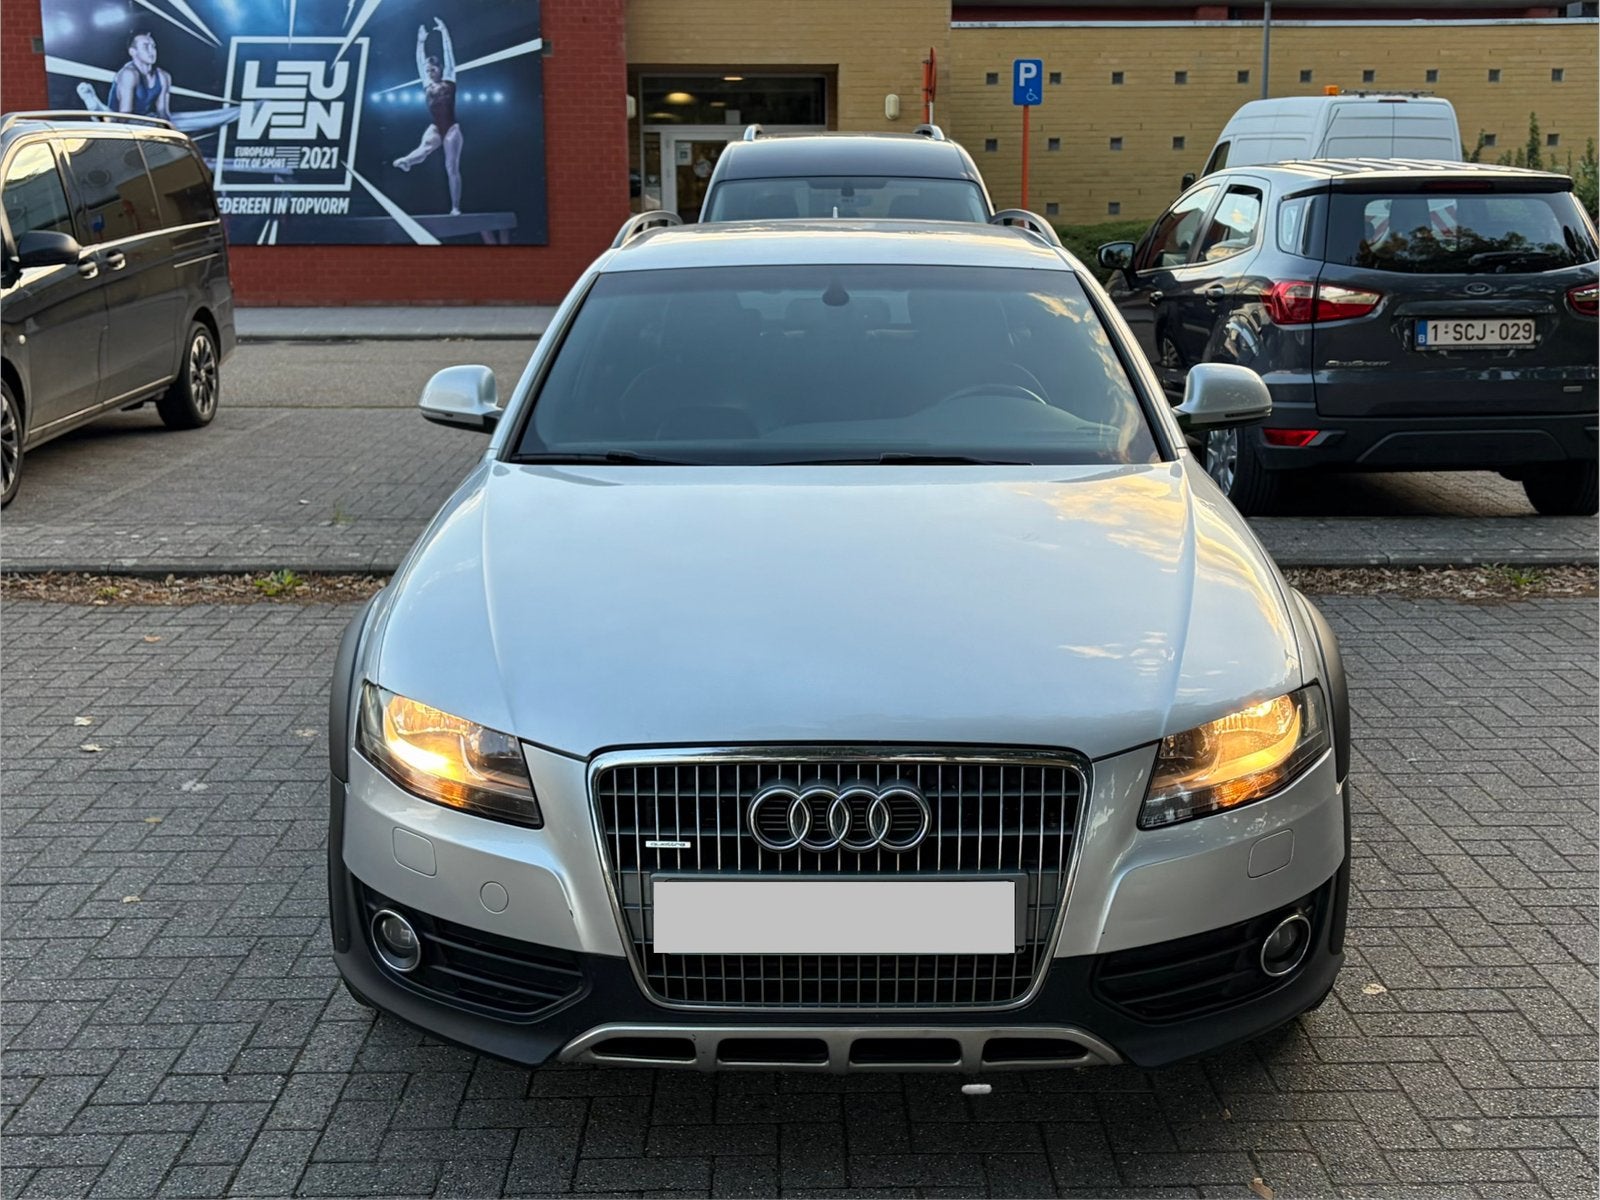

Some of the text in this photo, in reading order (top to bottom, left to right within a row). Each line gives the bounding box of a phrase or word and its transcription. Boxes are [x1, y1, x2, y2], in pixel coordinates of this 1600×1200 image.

[241, 60, 350, 100] LEU
[1019, 62, 1037, 87] P
[236, 100, 345, 140] VEN
[234, 146, 275, 157] EUROPEAN
[300, 146, 339, 169] 2021
[233, 158, 286, 168] CITY OF SPORT
[216, 197, 350, 214] EDEREEN IN TOPVORM
[1417, 334, 1426, 344] B
